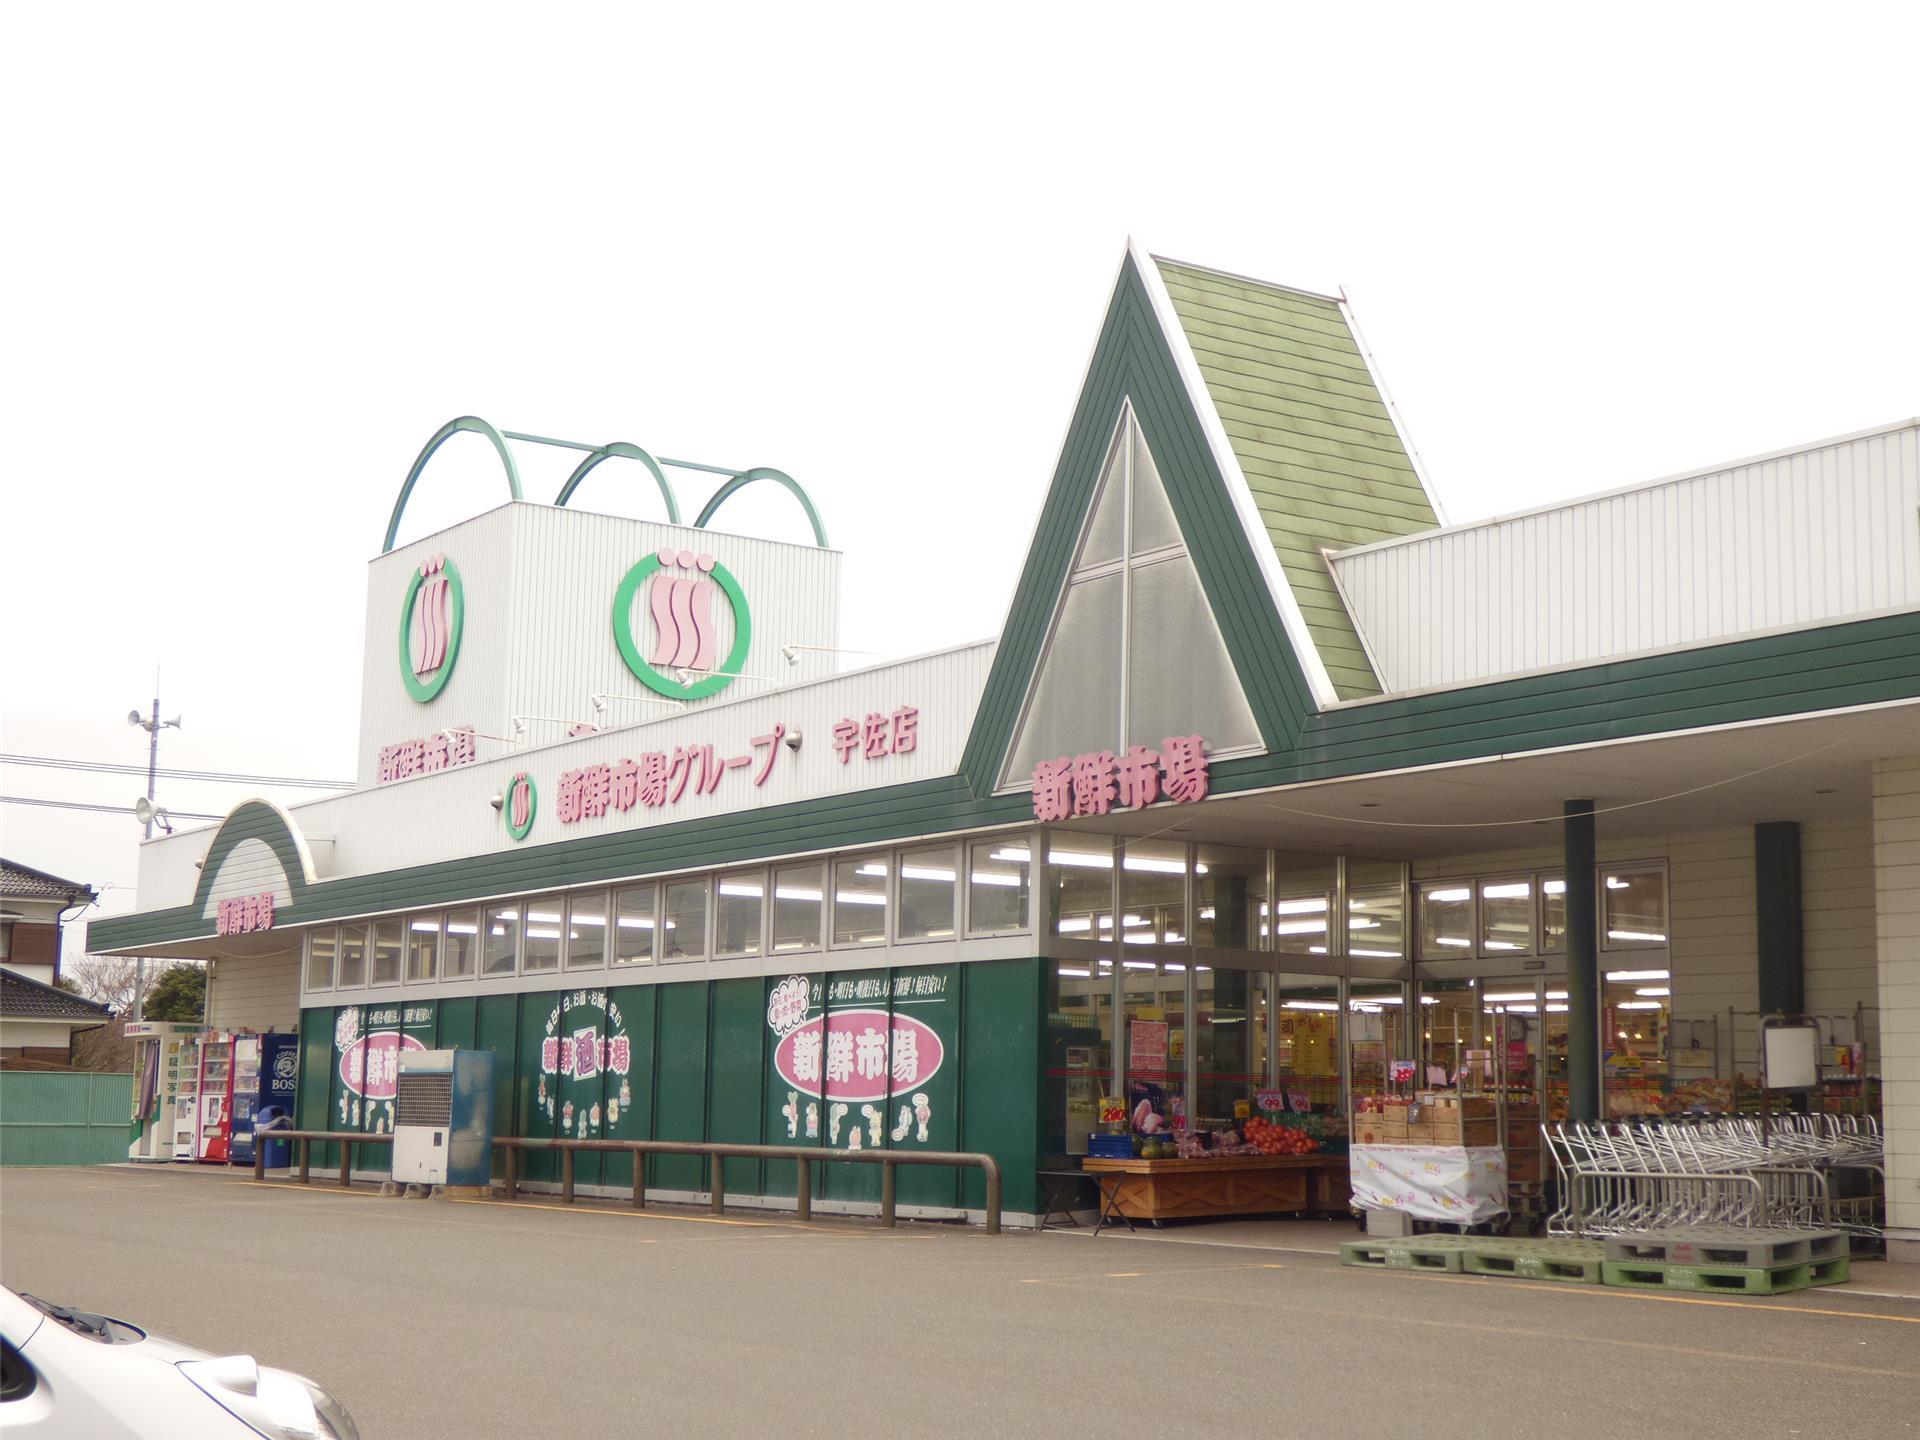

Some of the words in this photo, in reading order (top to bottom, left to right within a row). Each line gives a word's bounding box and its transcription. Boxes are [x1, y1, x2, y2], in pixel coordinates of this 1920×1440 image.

[558, 724, 785, 823] 新鮮市場グループ
[833, 707, 918, 763] 宇佐店
[1032, 735, 1208, 822] 新鮮市場
[216, 892, 273, 936] 新鮮市場
[349, 1045, 416, 1086] 新鮮市
[793, 1028, 919, 1083] 新鮮市場
[272, 1079, 297, 1090] BOS
